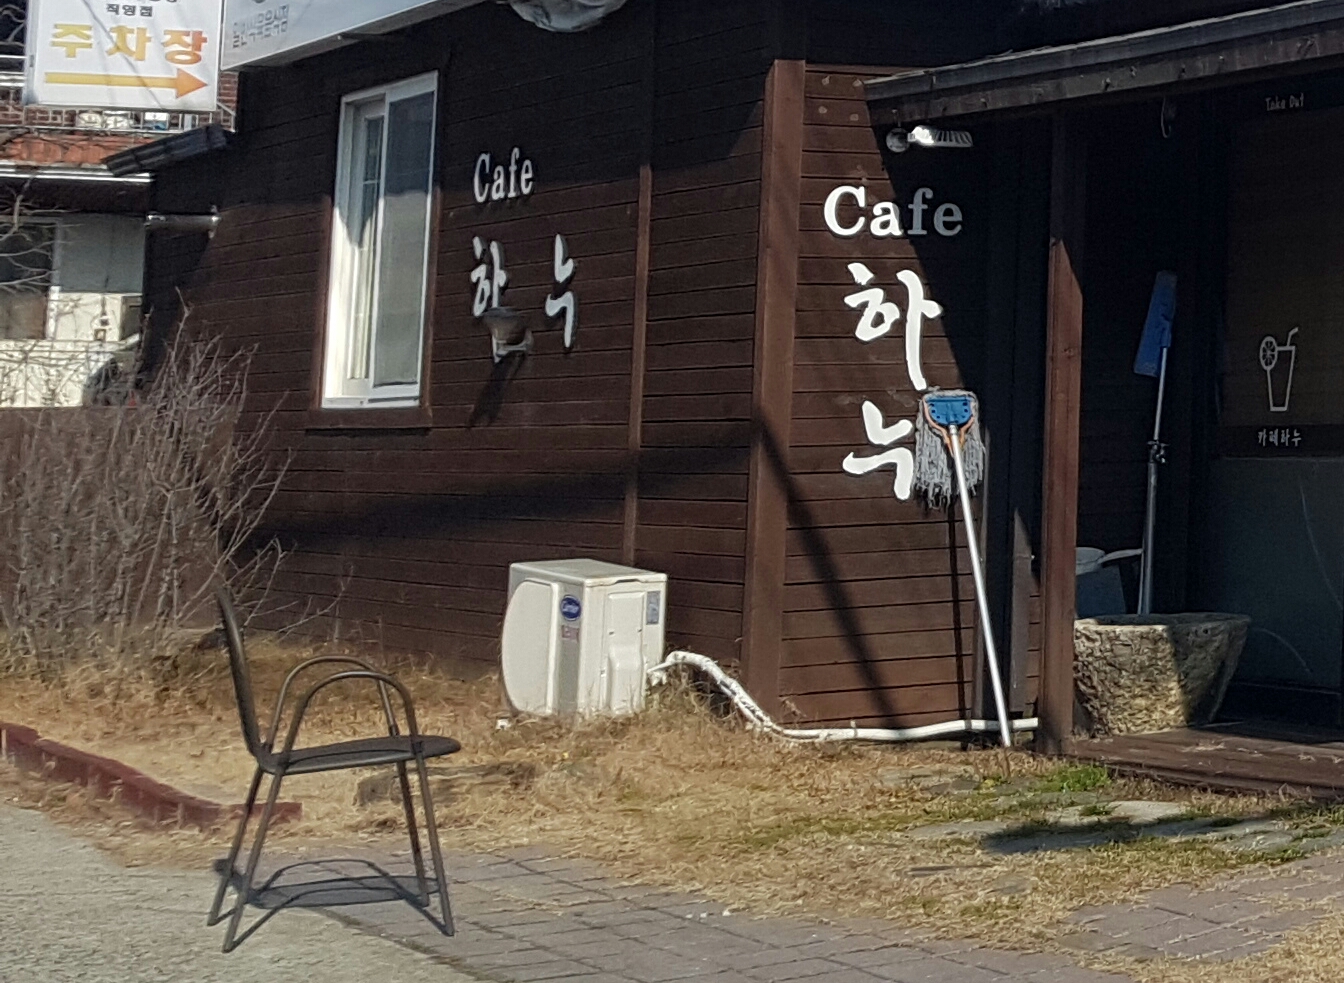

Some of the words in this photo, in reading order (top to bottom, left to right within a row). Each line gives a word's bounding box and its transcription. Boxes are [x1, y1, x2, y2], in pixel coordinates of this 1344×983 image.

[51, 23, 208, 66] 주차장
[473, 147, 534, 203] Cafe
[823, 185, 964, 237] Cafe
[1257, 428, 1303, 448] 카페하누
